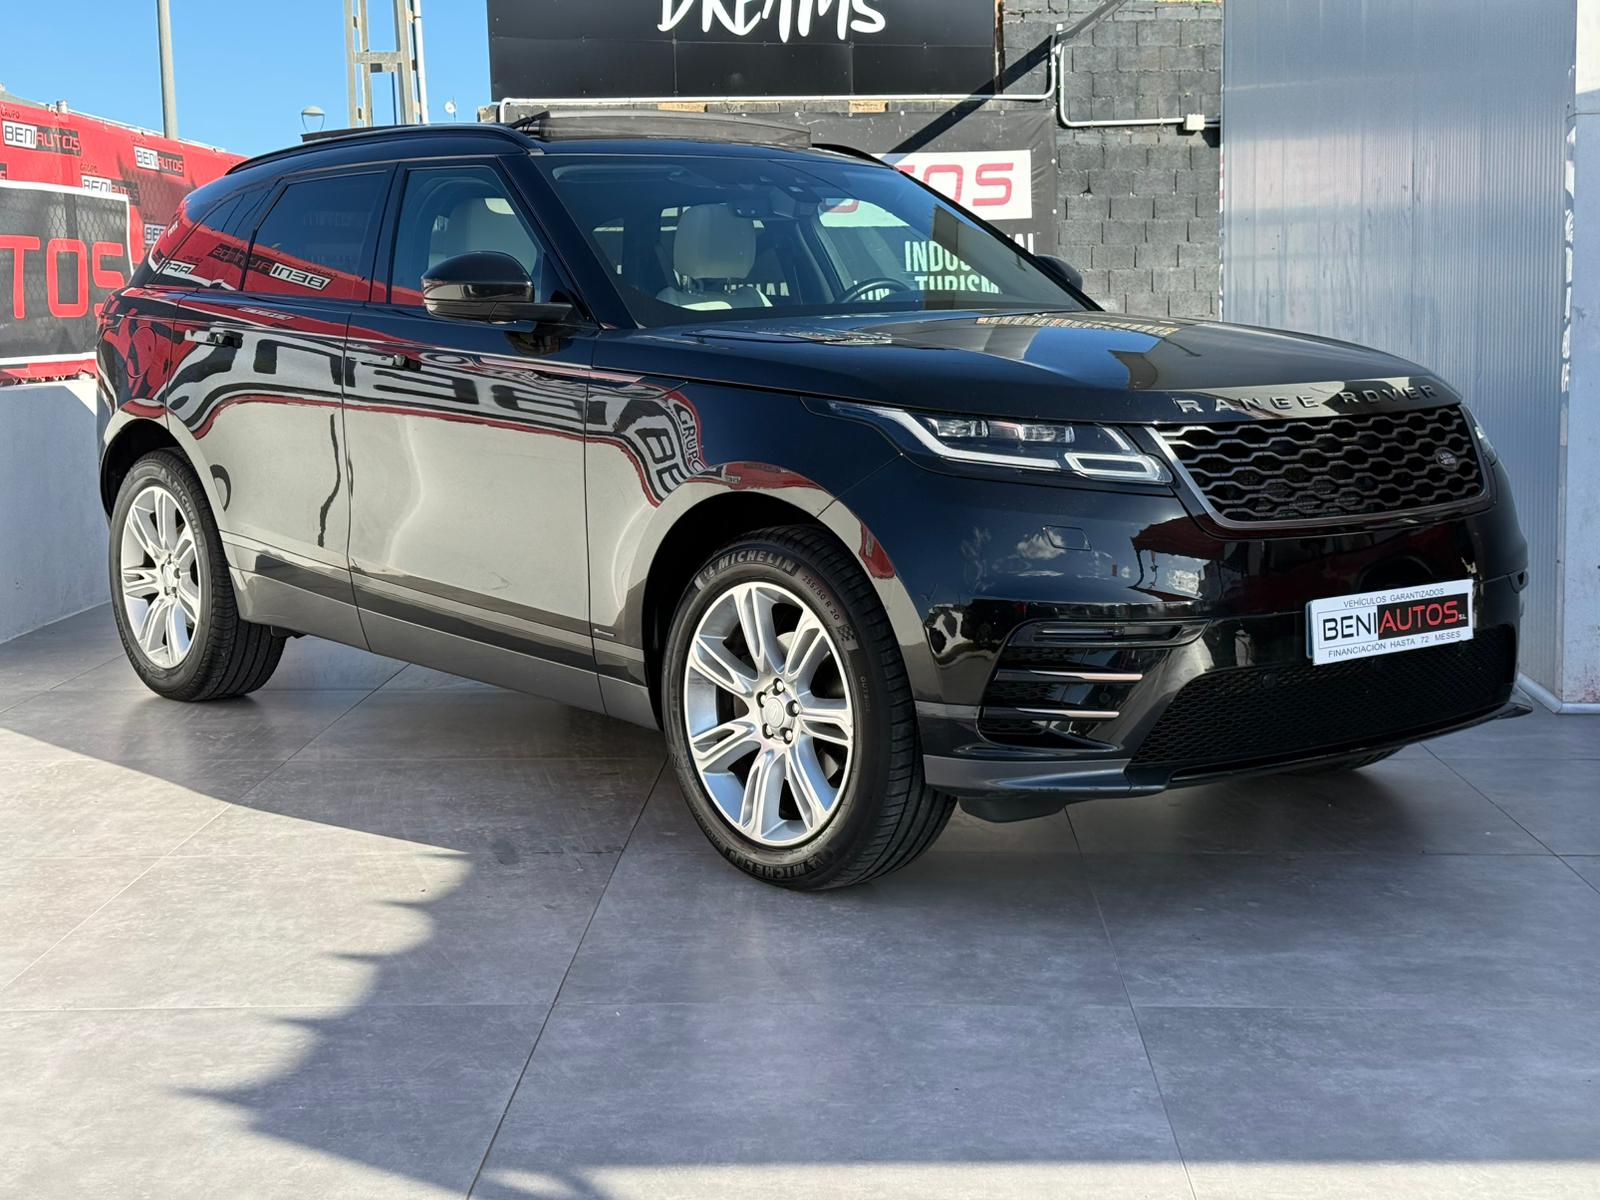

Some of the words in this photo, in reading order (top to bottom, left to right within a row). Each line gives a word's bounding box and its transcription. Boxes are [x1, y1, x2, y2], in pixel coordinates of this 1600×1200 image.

[1173, 394, 1319, 414] RANGE
[718, 550, 797, 574] MICHELIN
[801, 575, 827, 601] 255/50
[1389, 588, 1445, 602] GARANTIZADOS
[1390, 636, 1416, 648] HASTA
[1420, 635, 1430, 644] 72
[1434, 630, 1461, 642] MESES
